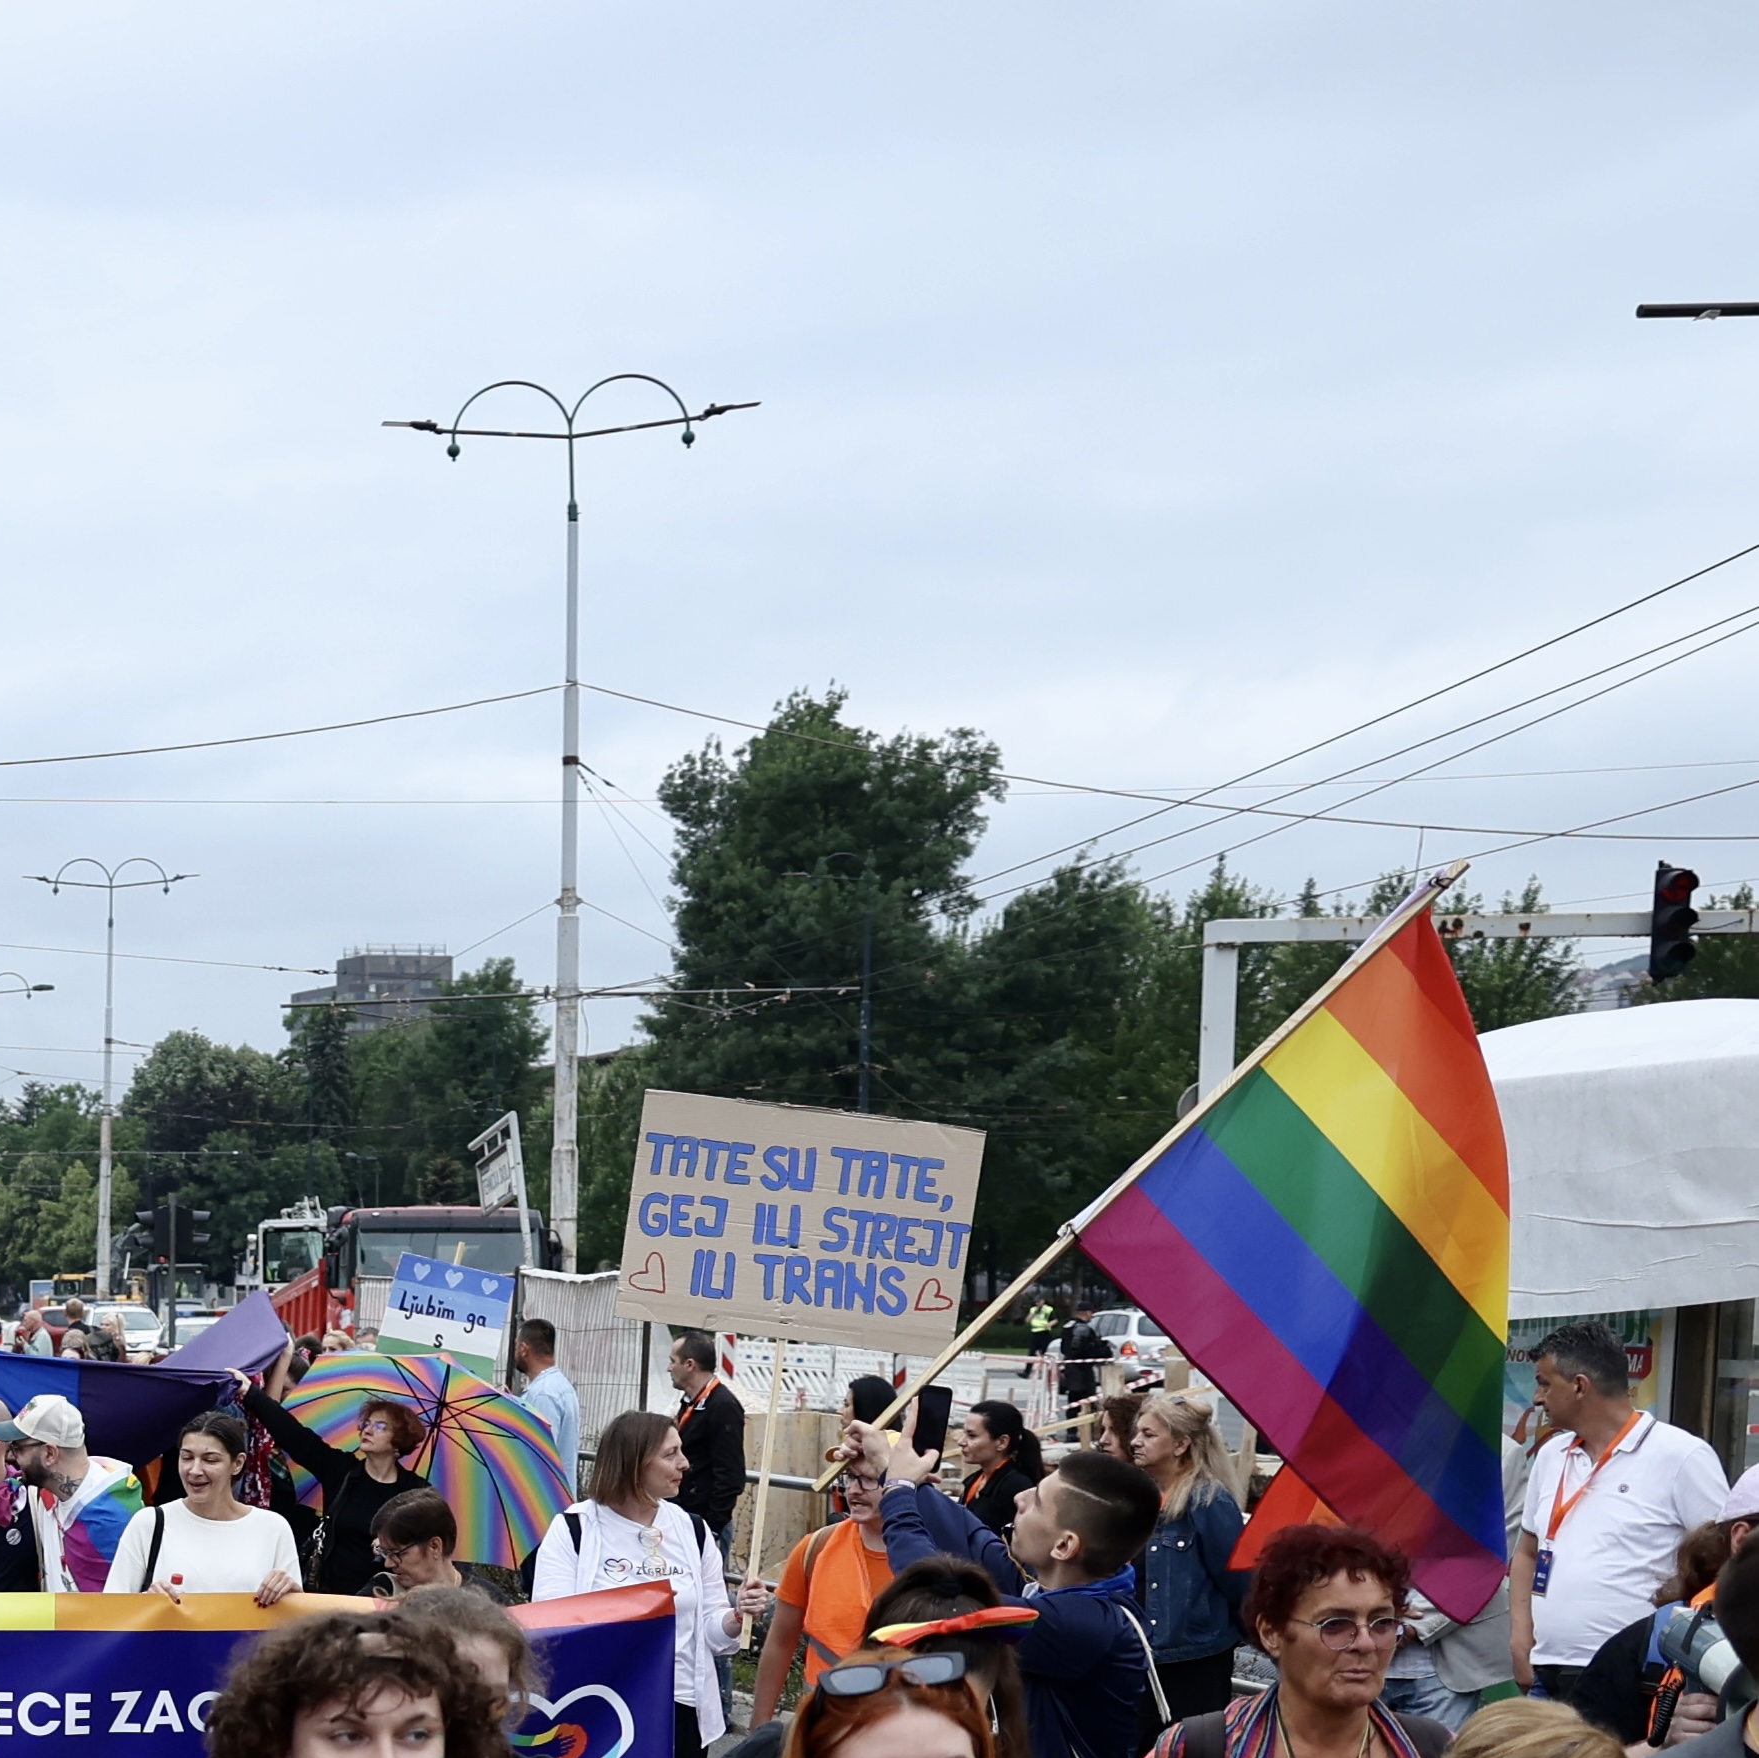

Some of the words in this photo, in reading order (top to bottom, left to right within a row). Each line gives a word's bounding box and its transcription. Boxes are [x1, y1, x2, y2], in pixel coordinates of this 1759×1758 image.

[646, 1132, 756, 1185] TATE
[760, 1145, 818, 1192] SU
[831, 1147, 954, 1213] TATE,
[639, 1192, 728, 1237] GEJ
[752, 1202, 801, 1248] ILI
[819, 1206, 972, 1270] STREJT
[398, 1290, 455, 1320] Ljubim
[463, 1312, 487, 1334] ga
[689, 1249, 736, 1300] ILI
[753, 1253, 908, 1317] TRANS
